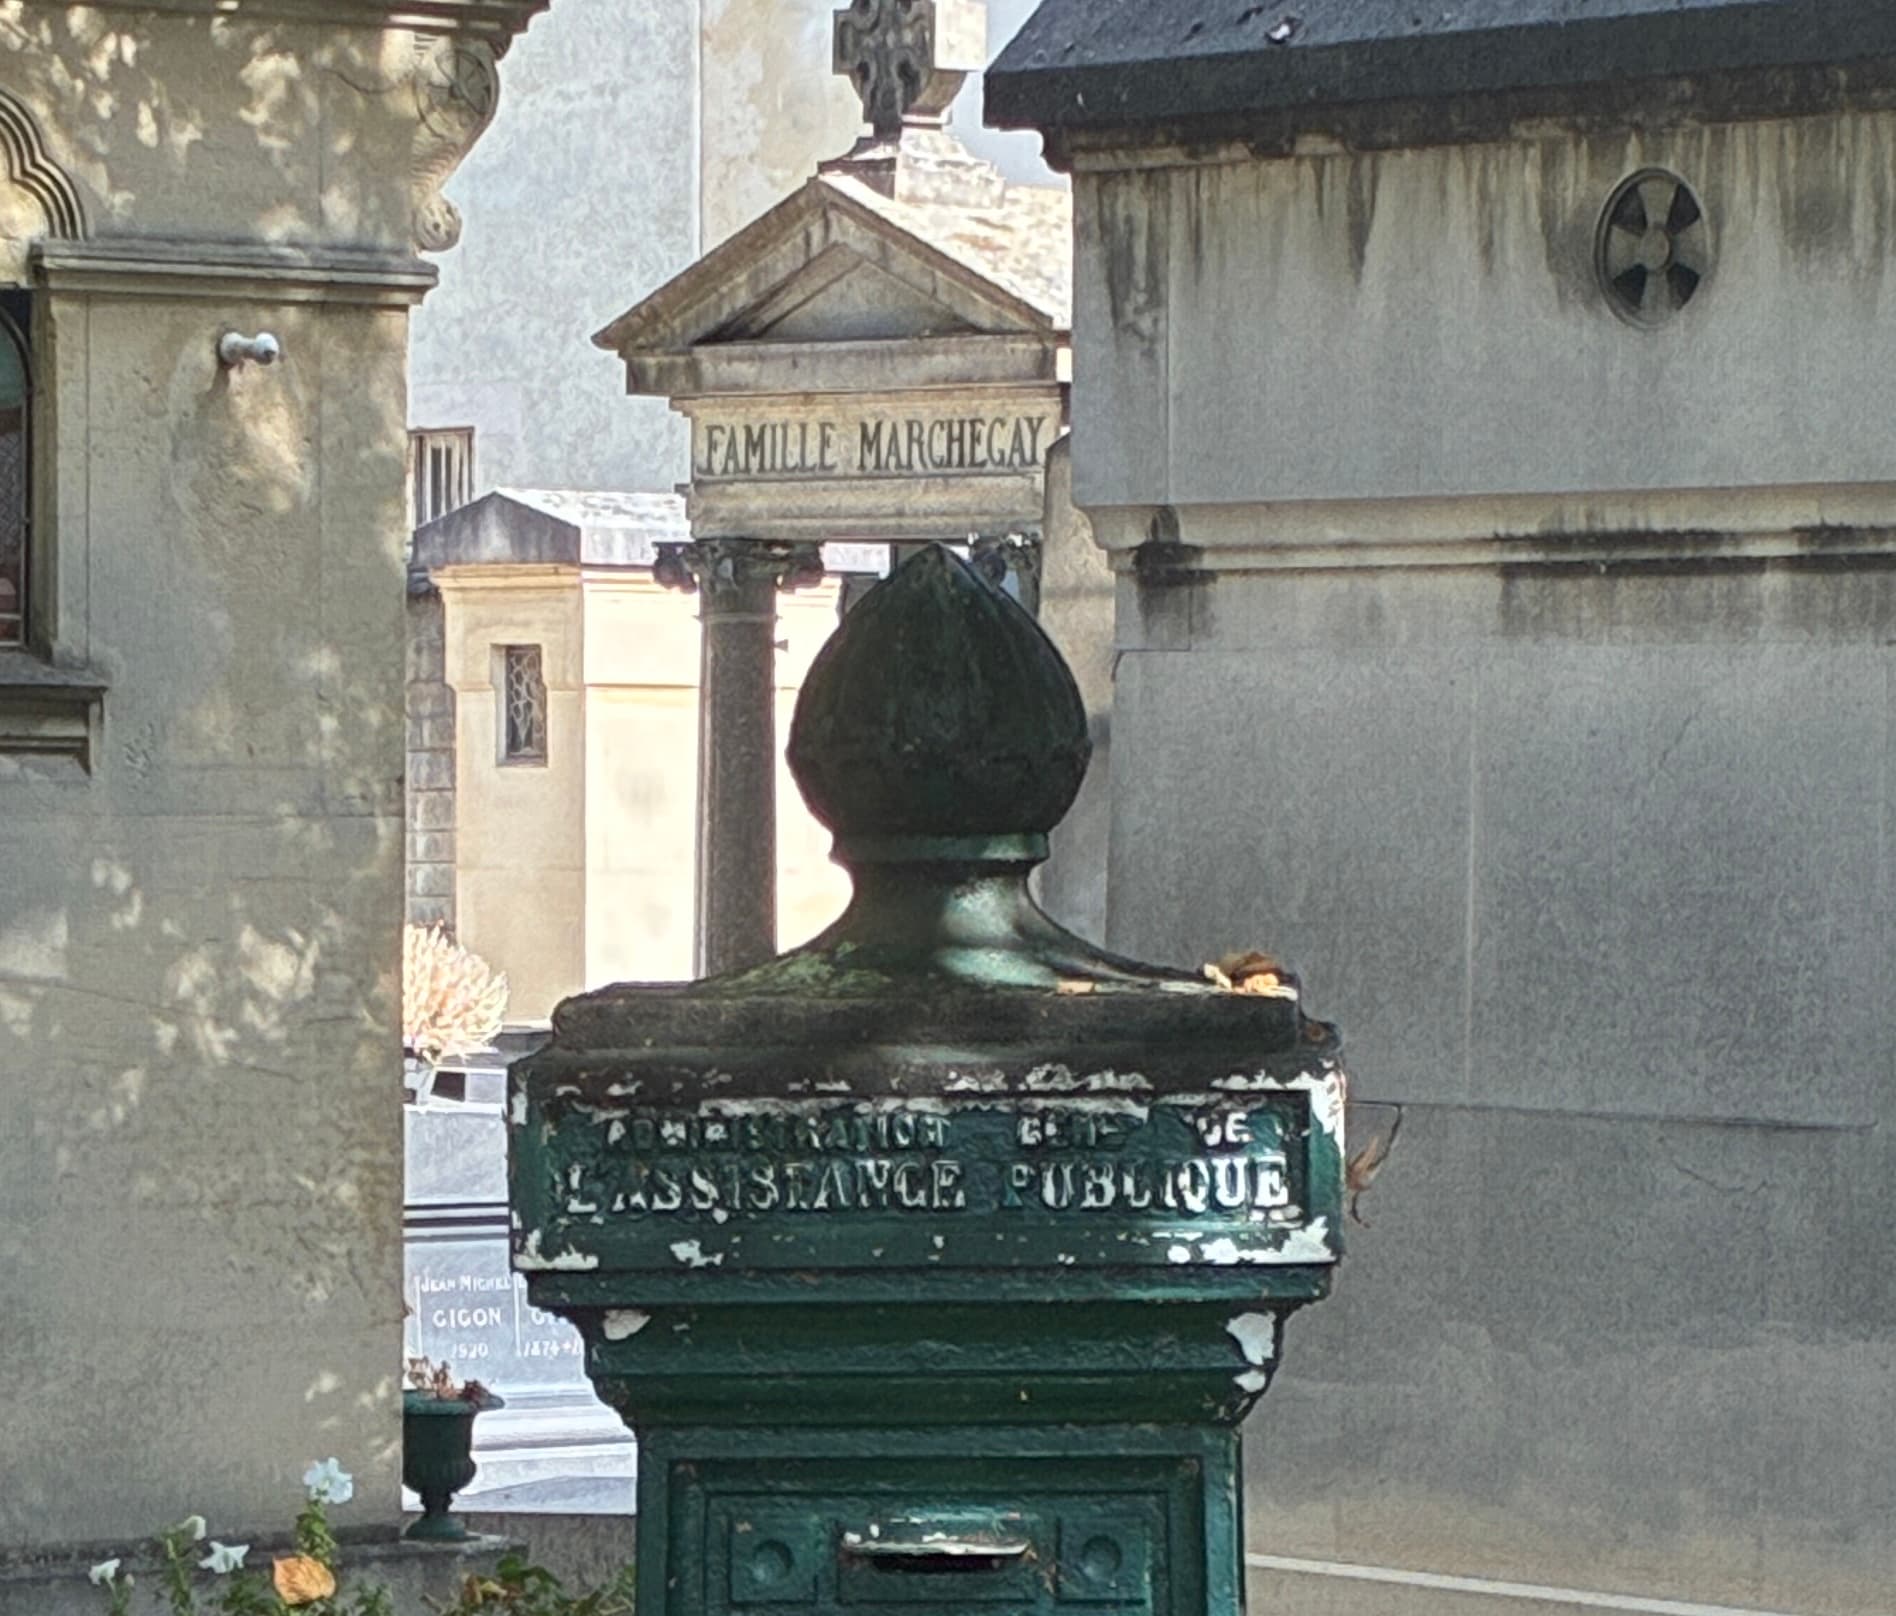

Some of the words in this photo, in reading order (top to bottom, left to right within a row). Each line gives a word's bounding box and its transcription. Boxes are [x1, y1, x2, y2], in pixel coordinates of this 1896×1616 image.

[699, 421, 836, 476] FAMILLE
[857, 416, 1047, 471] MARCHEGAY
[1003, 1156, 1289, 1212] PUBLIQUE
